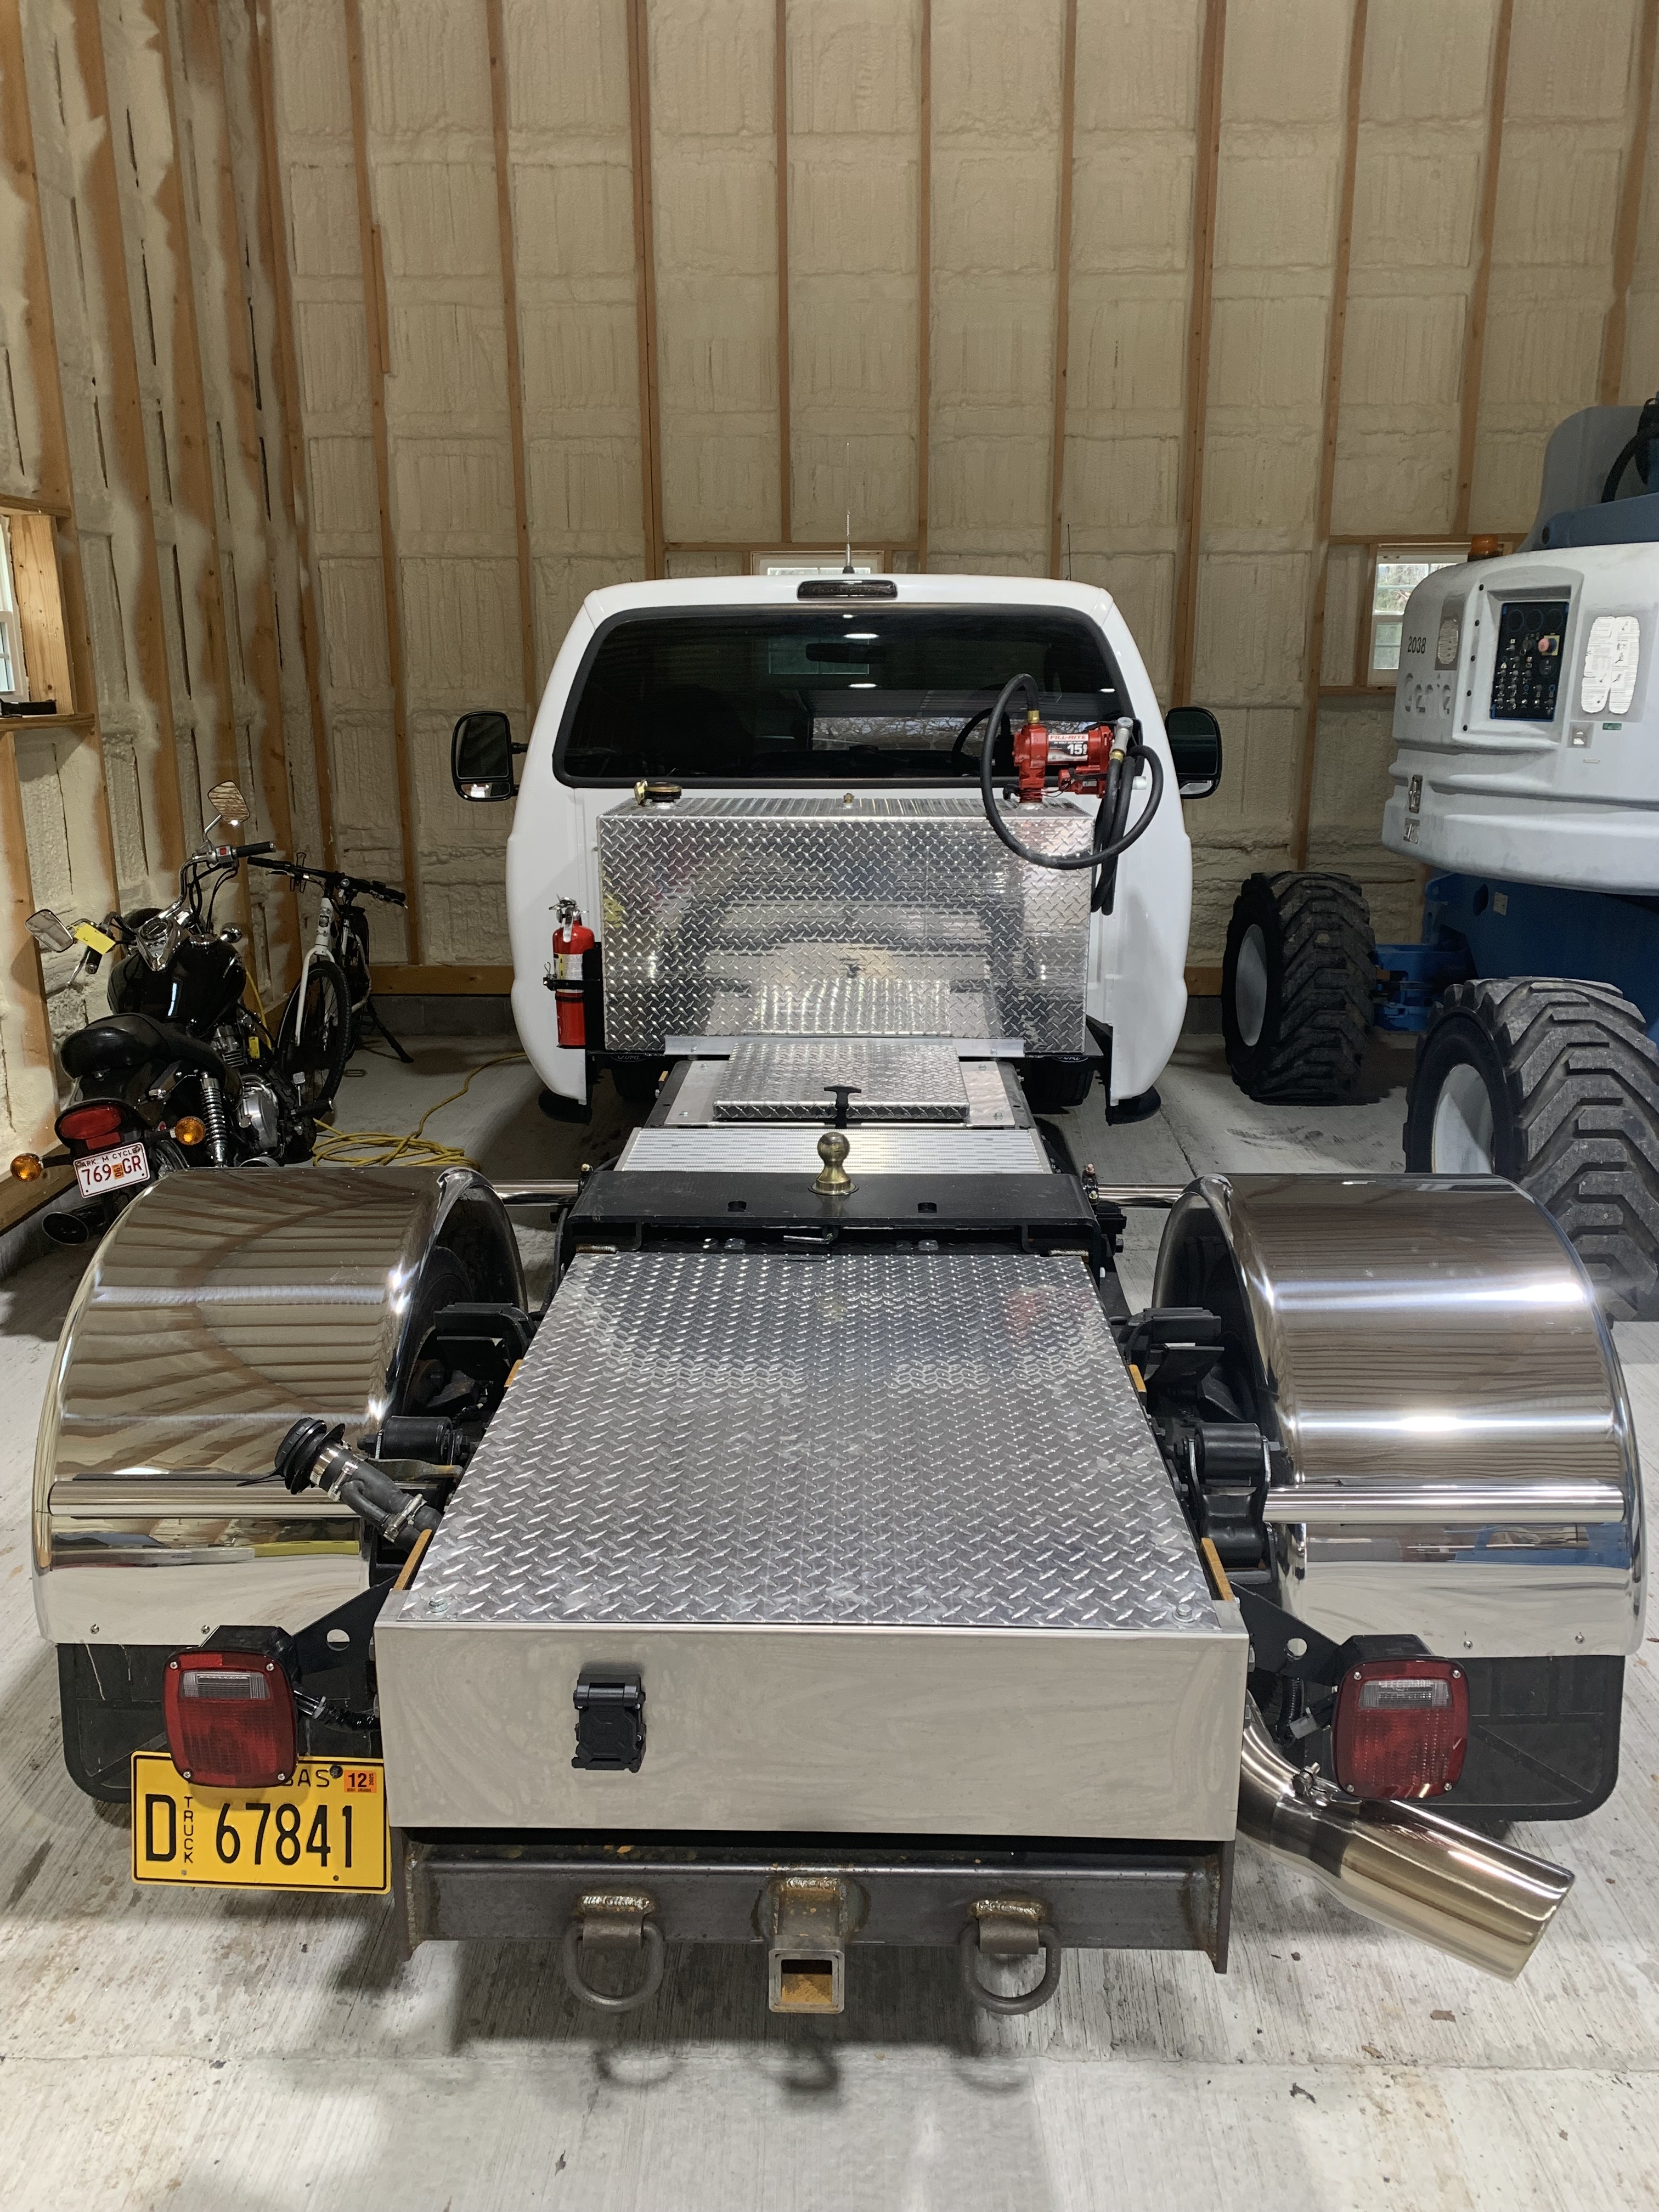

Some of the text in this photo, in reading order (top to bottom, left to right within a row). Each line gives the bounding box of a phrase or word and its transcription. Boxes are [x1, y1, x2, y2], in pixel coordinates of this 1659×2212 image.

[1408, 636, 1426, 654] 2038
[1067, 744, 1082, 754] 15
[81, 1164, 112, 1186] 769
[122, 1155, 143, 1174] GR
[348, 1773, 367, 1787] 12
[145, 1794, 176, 1861] D
[216, 1803, 353, 1868] 67841
